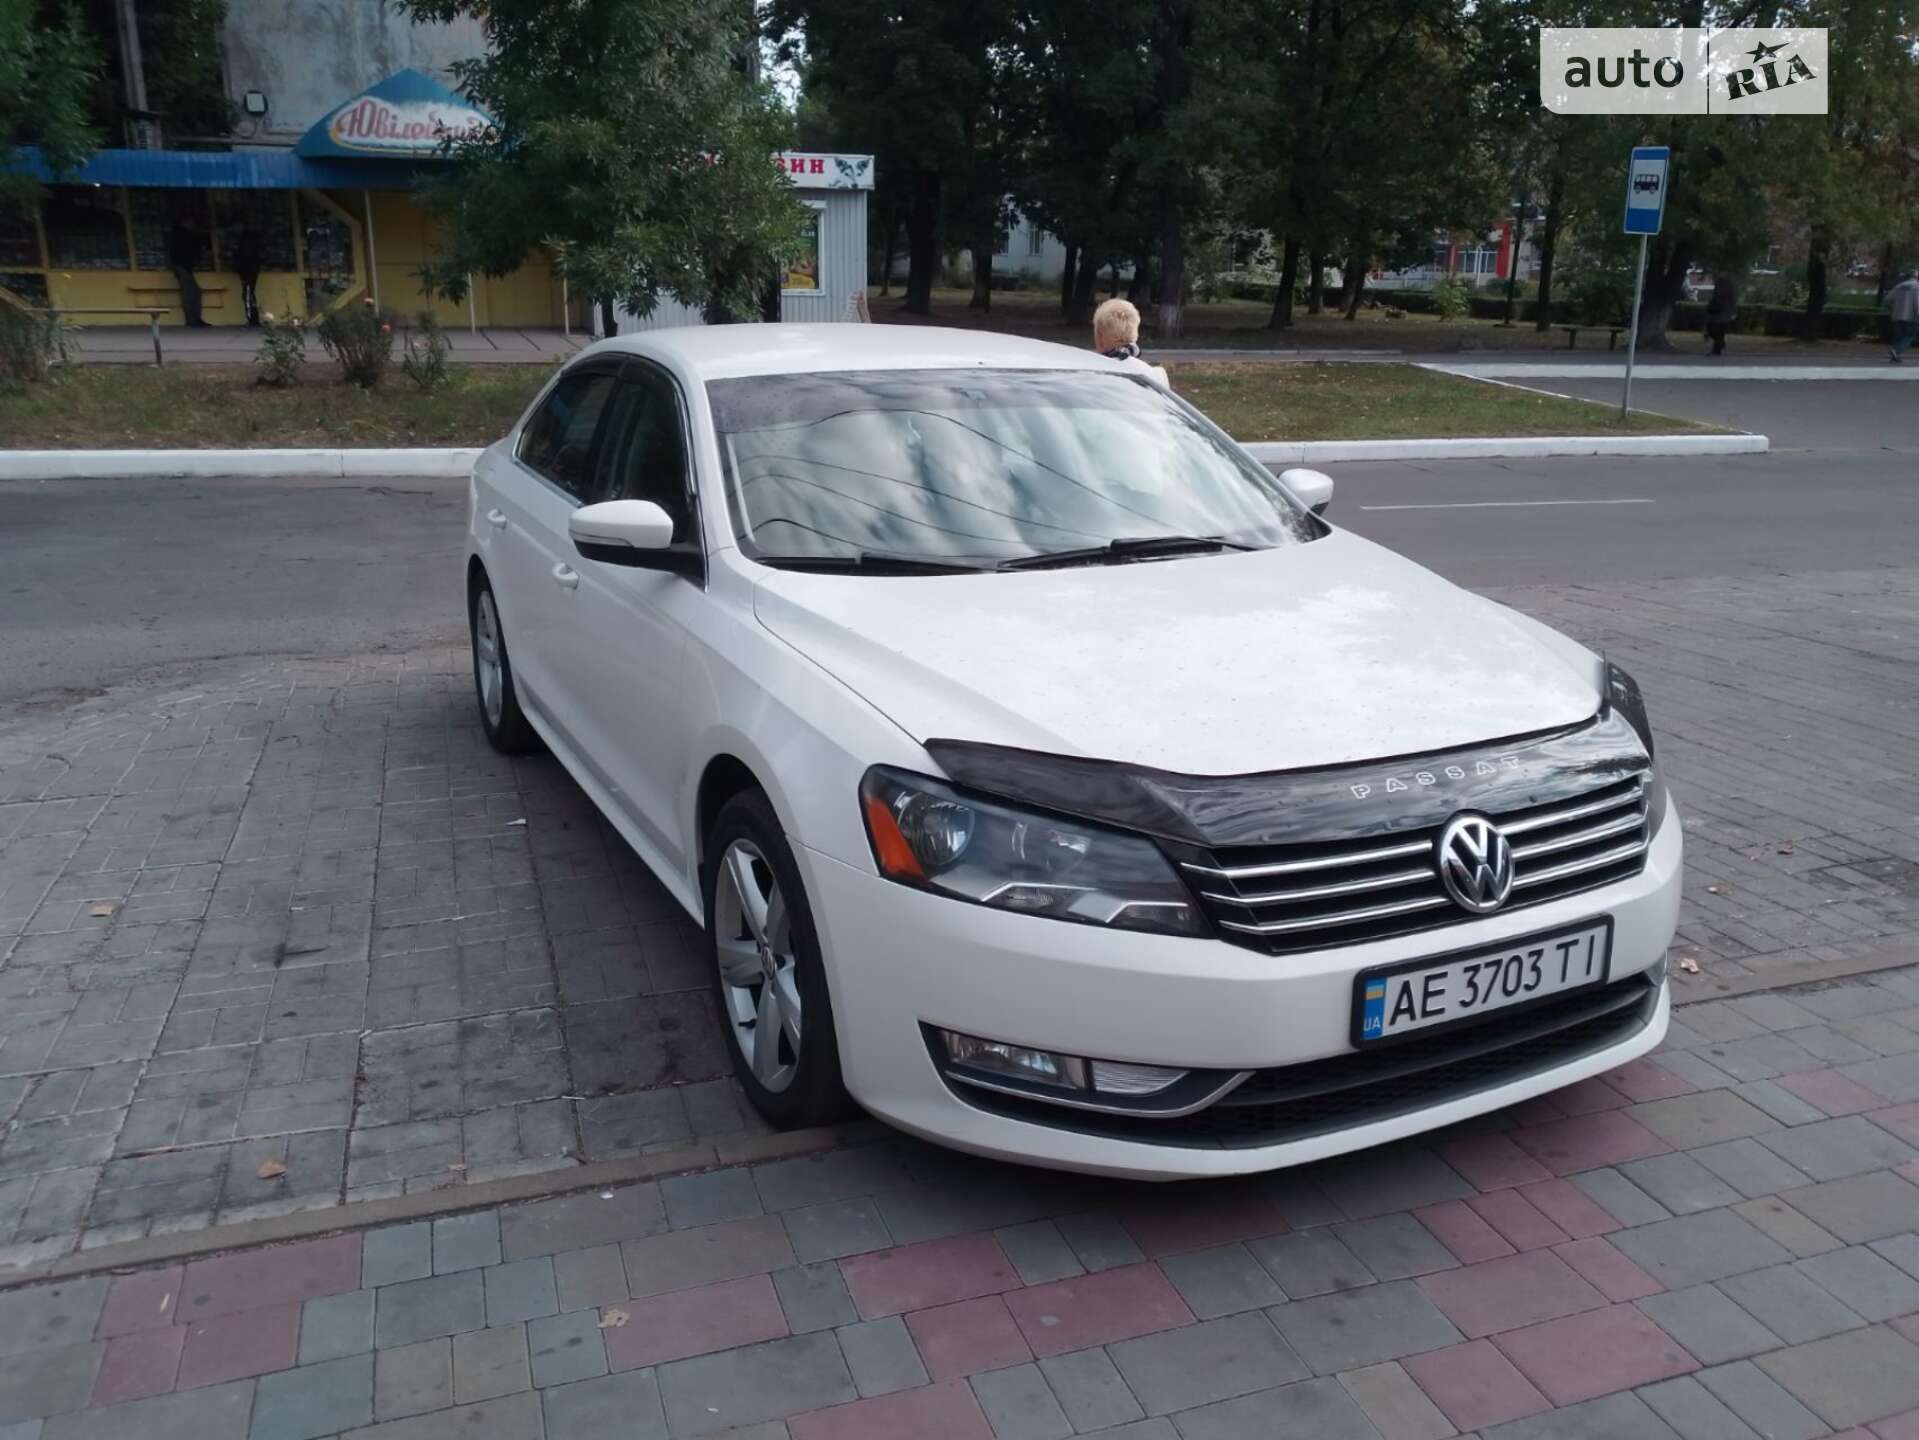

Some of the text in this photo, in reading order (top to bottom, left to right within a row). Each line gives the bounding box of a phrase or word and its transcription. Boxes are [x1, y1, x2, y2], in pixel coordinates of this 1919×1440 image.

[1350, 756, 1520, 800] PASSAT
[1388, 934, 1597, 1027] AE 3703 TI
[1363, 1016, 1382, 1032] UA
